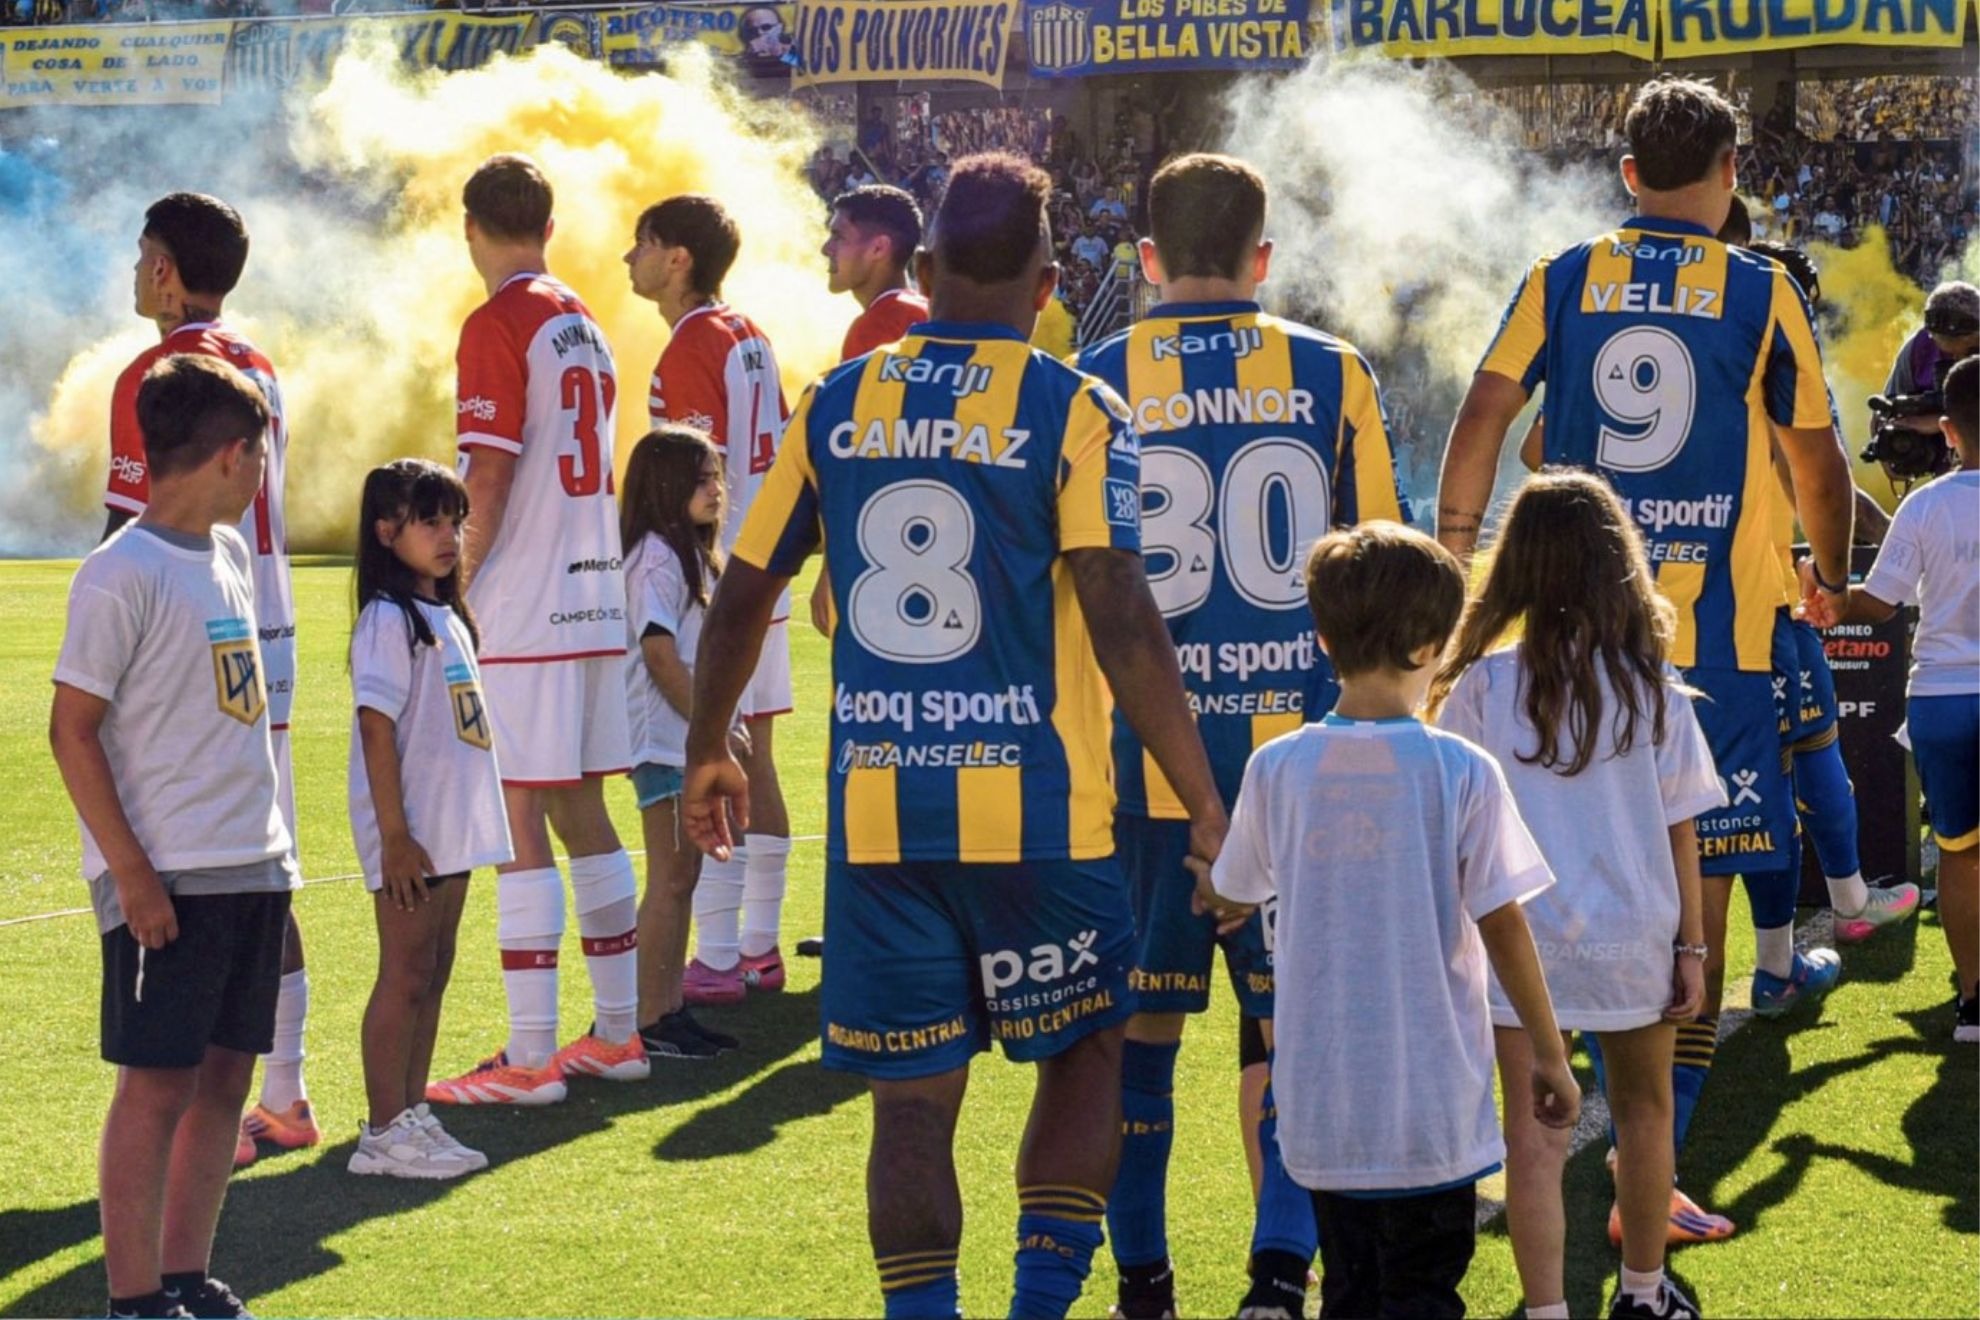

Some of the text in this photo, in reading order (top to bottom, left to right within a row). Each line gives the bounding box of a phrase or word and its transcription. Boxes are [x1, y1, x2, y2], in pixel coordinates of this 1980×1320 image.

[1120, 0, 1287, 19] LOS PIBES DE
[13, 32, 226, 51] DEJANDO CUALQUIER
[796, 4, 1008, 76] LOS POLVORINES
[1093, 20, 1303, 63] BELLA VISTA
[32, 54, 199, 70] COSA DE LADO
[73, 79, 138, 94] VERTE
[1590, 282, 1718, 319] VELIZ
[1136, 386, 1315, 432] CONNOR
[1592, 325, 1697, 473] 9
[827, 417, 1031, 470] CAMPAZ
[1637, 493, 1733, 533] sportif
[848, 477, 982, 664] 8
[1821, 639, 1891, 658] etano
[855, 741, 1022, 768] TRANSELEC
[986, 976, 1097, 1012] assistance
[1039, 989, 1115, 1034] CENTRAL
[886, 1014, 967, 1052] CENTRAL
